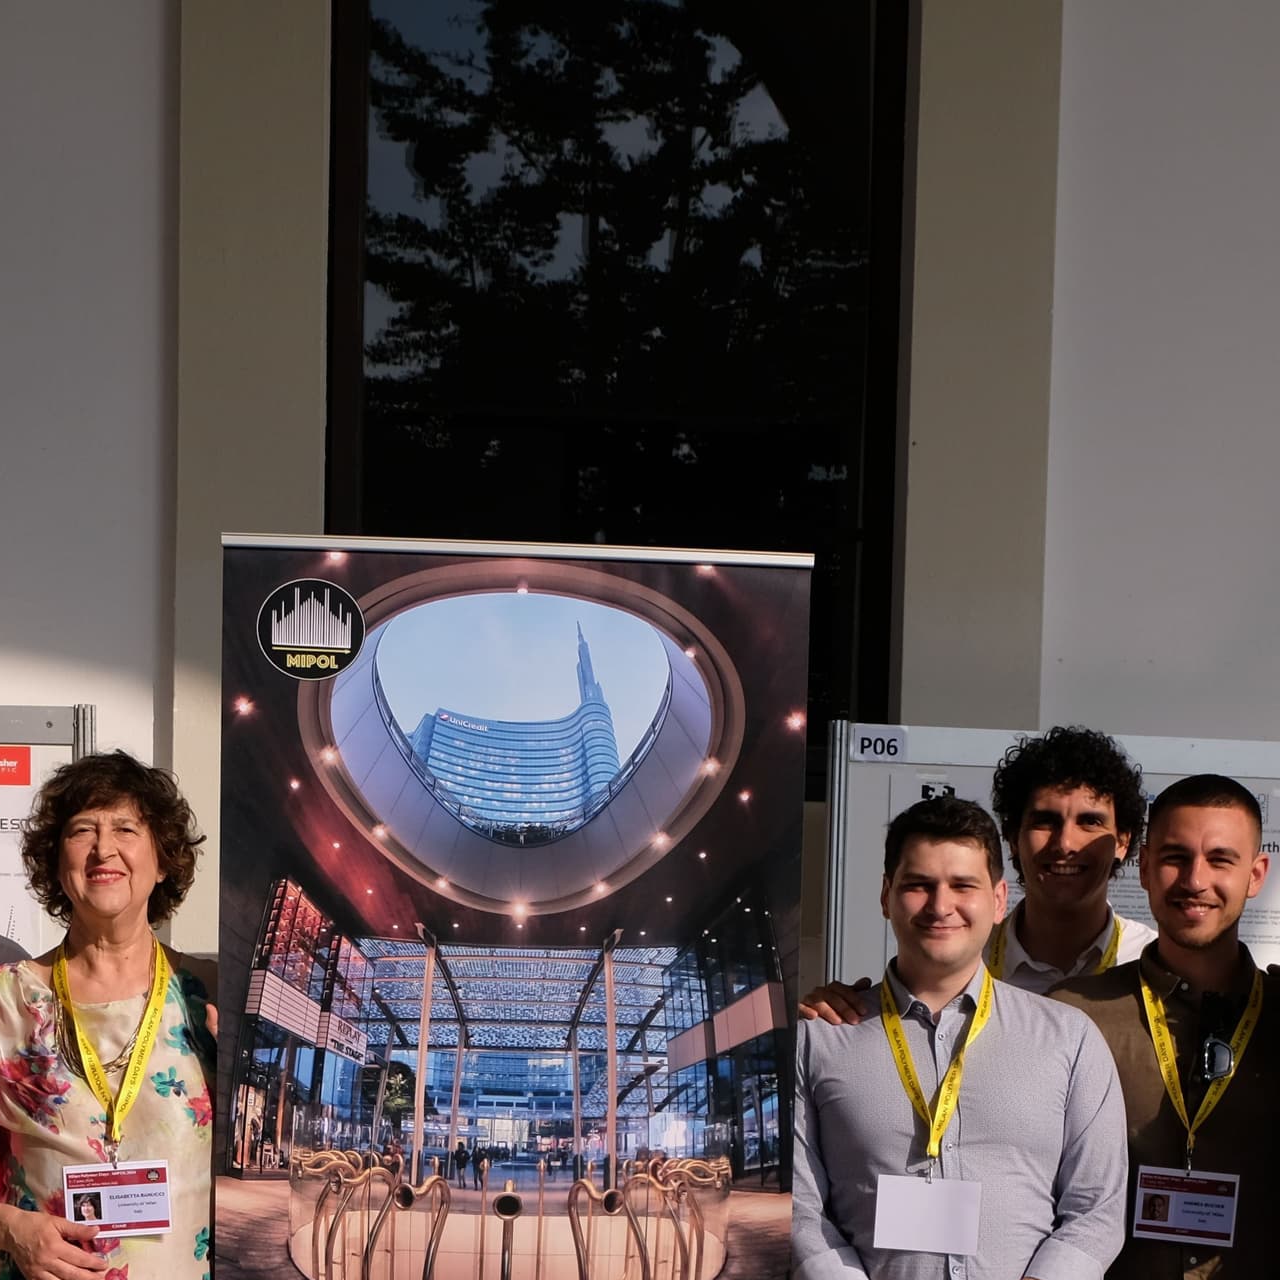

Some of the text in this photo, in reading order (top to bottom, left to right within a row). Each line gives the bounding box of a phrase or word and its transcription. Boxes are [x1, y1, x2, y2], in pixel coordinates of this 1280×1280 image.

[286, 654, 338, 669] MIPOL
[448, 716, 489, 733] UniCredit
[860, 737, 898, 756] P06
[134, 1030, 153, 1067] POLYMER
